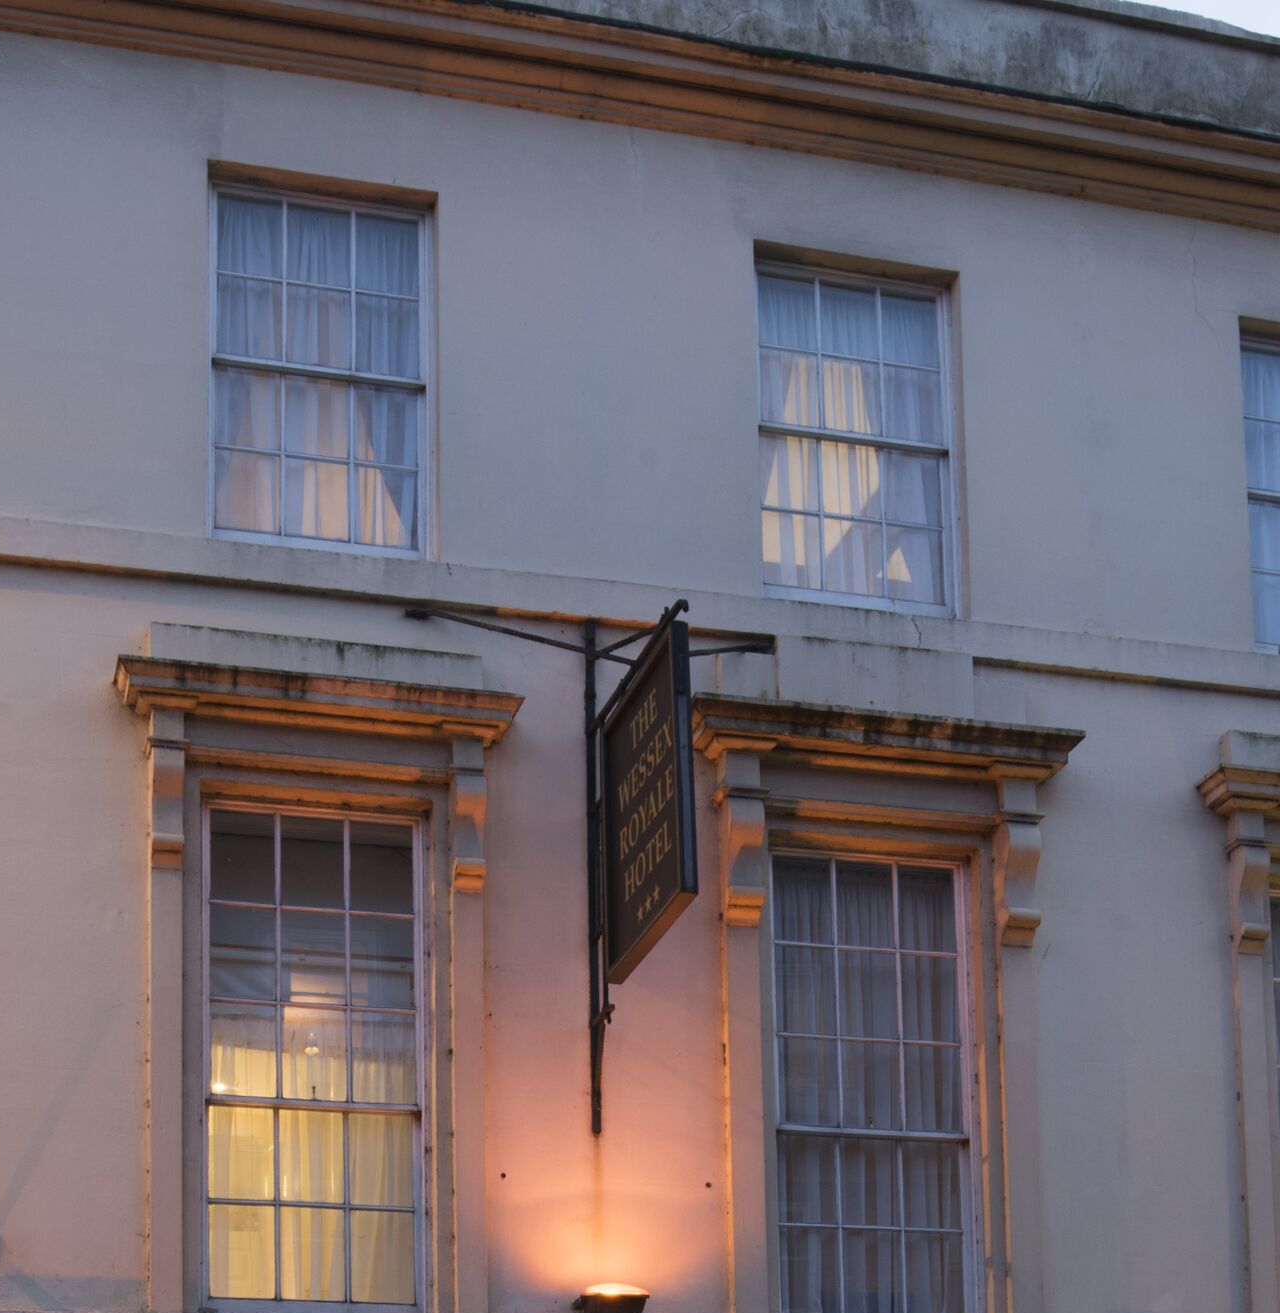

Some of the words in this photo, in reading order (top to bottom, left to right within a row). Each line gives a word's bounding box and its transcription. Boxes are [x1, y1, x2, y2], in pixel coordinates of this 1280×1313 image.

[618, 714, 673, 814] WESSEX
[629, 688, 658, 750] THE
[620, 763, 674, 861] ROYALE
[624, 819, 673, 902] HOTEL
